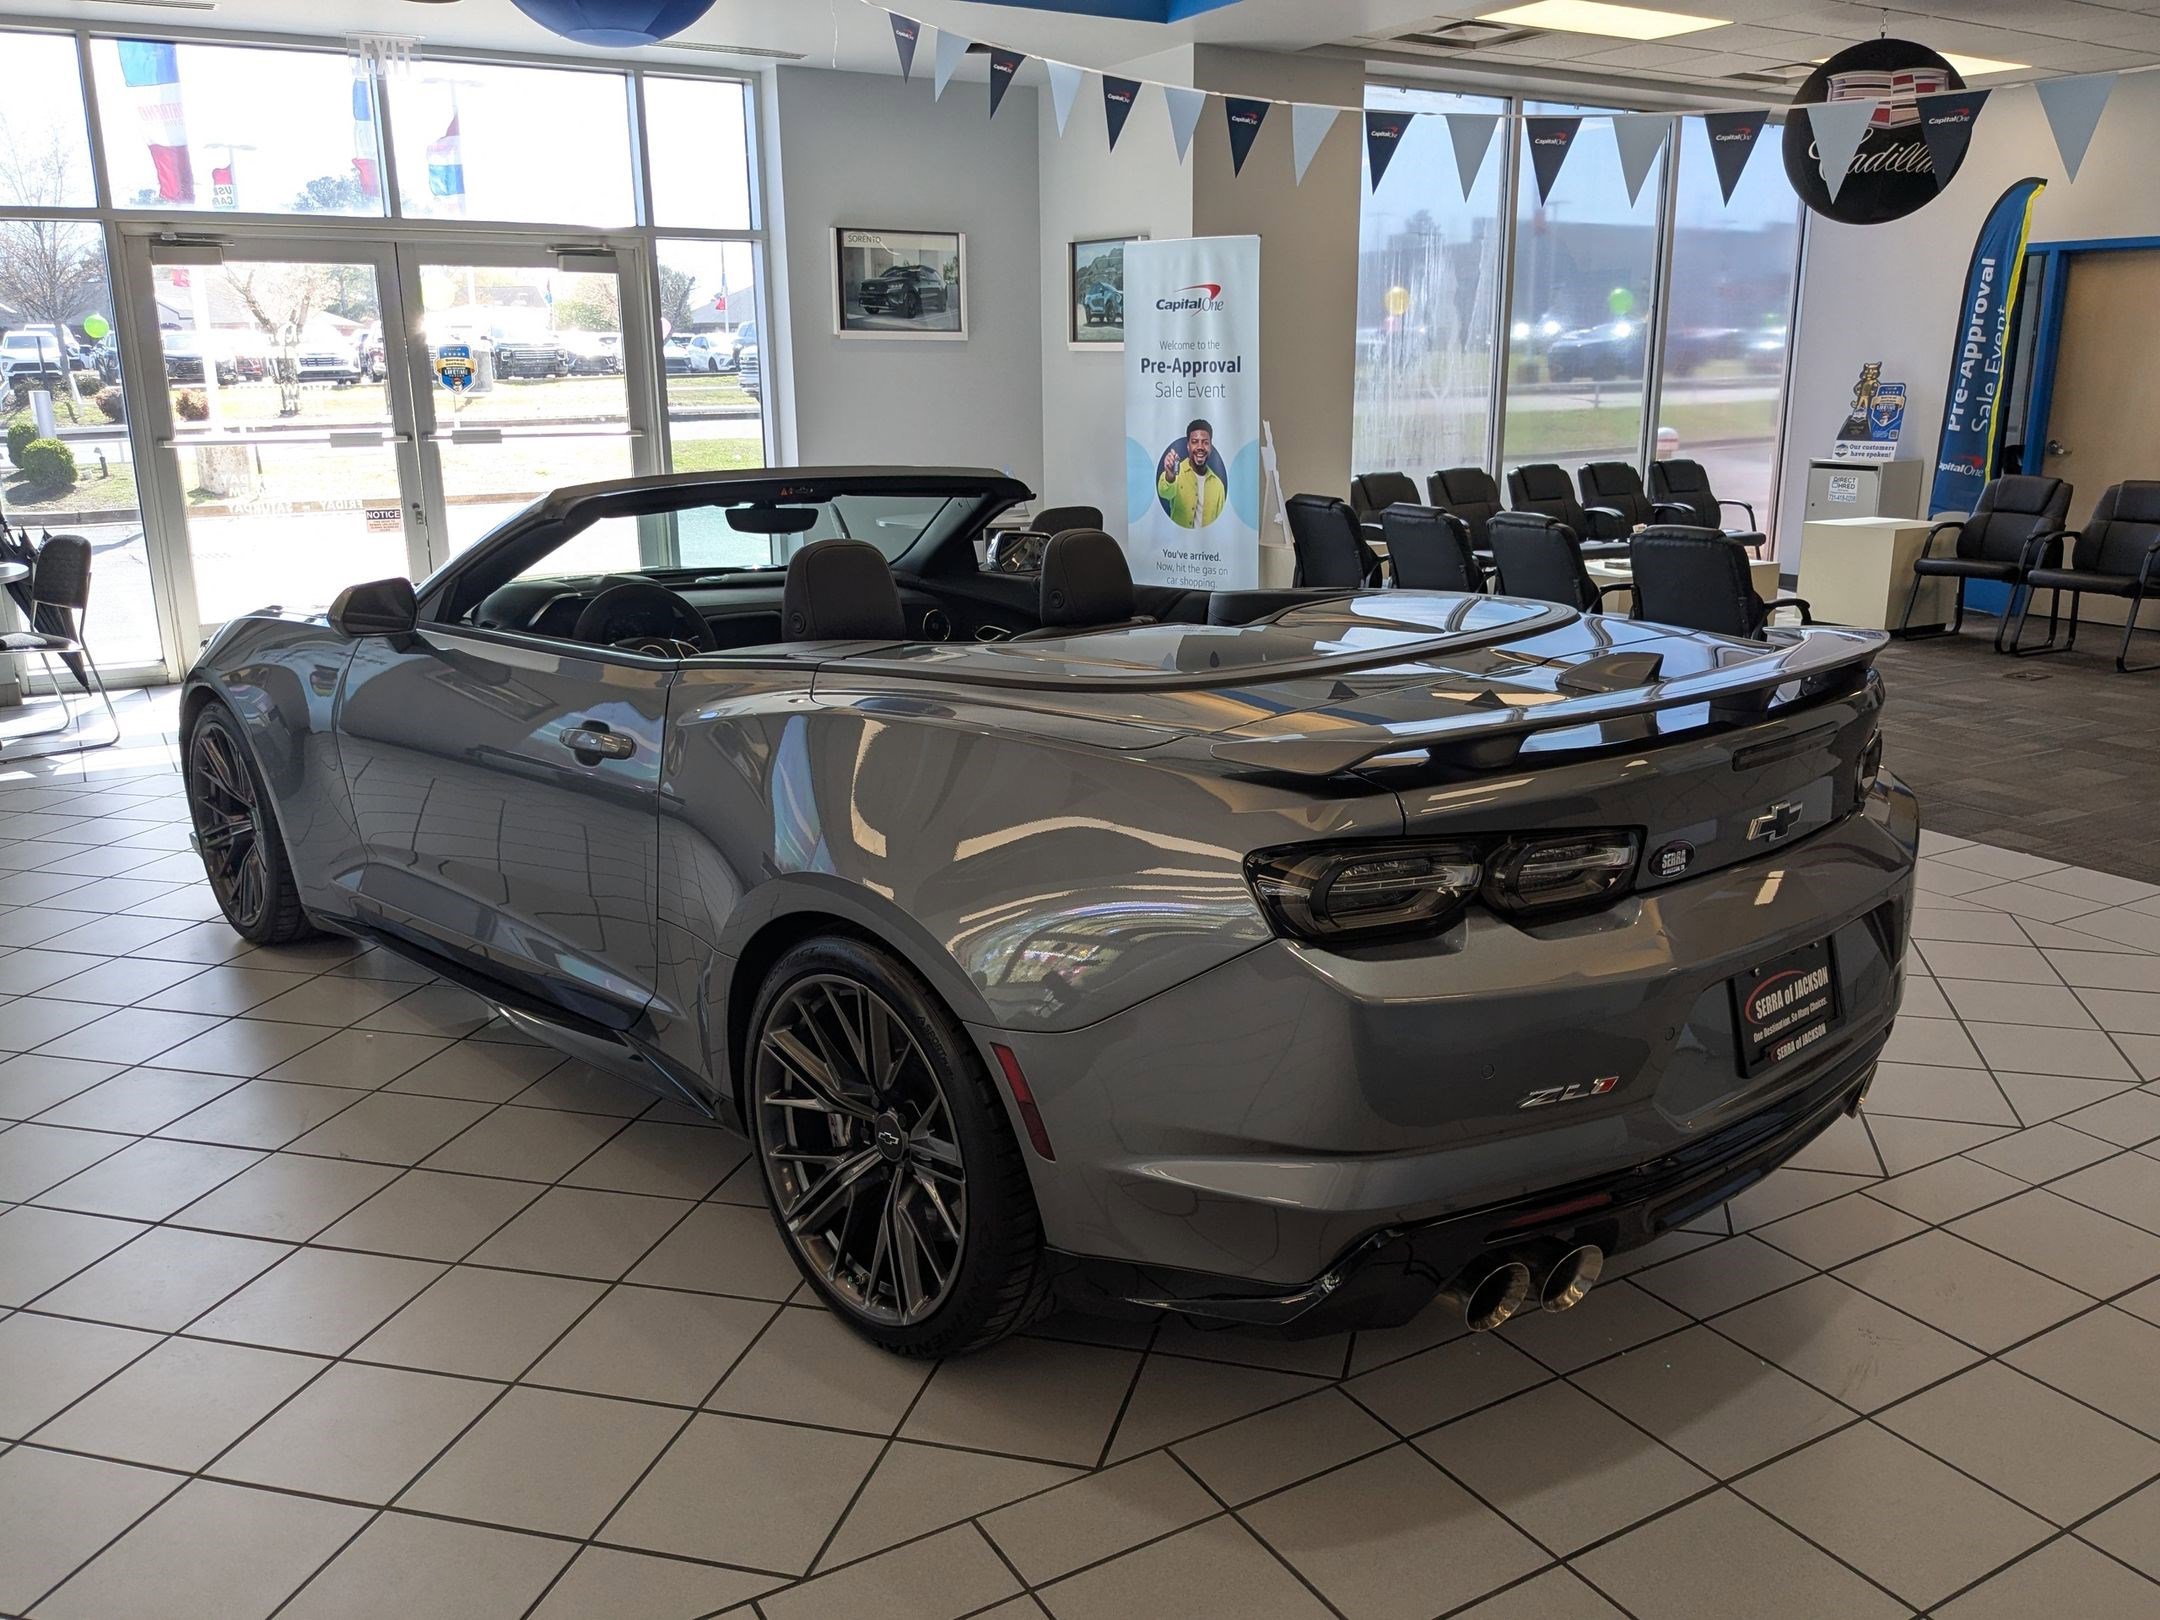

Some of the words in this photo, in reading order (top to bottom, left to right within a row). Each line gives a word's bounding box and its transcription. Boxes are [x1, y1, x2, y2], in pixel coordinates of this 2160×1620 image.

[360, 40, 414, 77] EXIT
[1808, 128, 1936, 181] adilla
[848, 234, 882, 244] SORENTO
[1160, 340, 1195, 351] Welcome
[1198, 341, 1206, 351] to
[1207, 338, 1220, 350] the
[1948, 258, 1996, 432] Pre-Approval
[1141, 355, 1241, 378] Pre-Approval
[1971, 382, 1995, 432] Sale
[1984, 304, 2006, 374] Event
[1155, 380, 1183, 398] Sale
[1188, 381, 1226, 399] Event
[1862, 443, 1895, 451] customers
[1866, 450, 1891, 459] spoken!
[1939, 462, 1984, 477] apitalOne
[366, 510, 401, 519] NOTICE
[1162, 548, 1188, 560] You've
[1190, 551, 1222, 562] arrived.
[1156, 561, 1174, 573] Now,
[1176, 563, 1186, 573] hit
[1188, 564, 1200, 574] the
[1202, 566, 1217, 576] gas
[1219, 567, 1228, 575] on
[1167, 576, 1178, 585] car
[1179, 577, 1218, 590] shopping.
[1662, 850, 1686, 869] SERRA
[1755, 989, 1784, 1020] SERRA
[1784, 984, 1794, 1005] of
[1794, 966, 1829, 999] JACKSON
[1753, 1031, 1764, 1043] One
[1763, 1016, 1791, 1040] Destination.
[1790, 1012, 1798, 1023] So
[1797, 1005, 1810, 1020] Many
[1809, 999, 1828, 1015] Choices.
[1776, 1040, 1795, 1061] SERRA
[1795, 1036, 1801, 1049] of
[1801, 1023, 1827, 1047] JACKSON
[1517, 1076, 1619, 1108] ZL1
